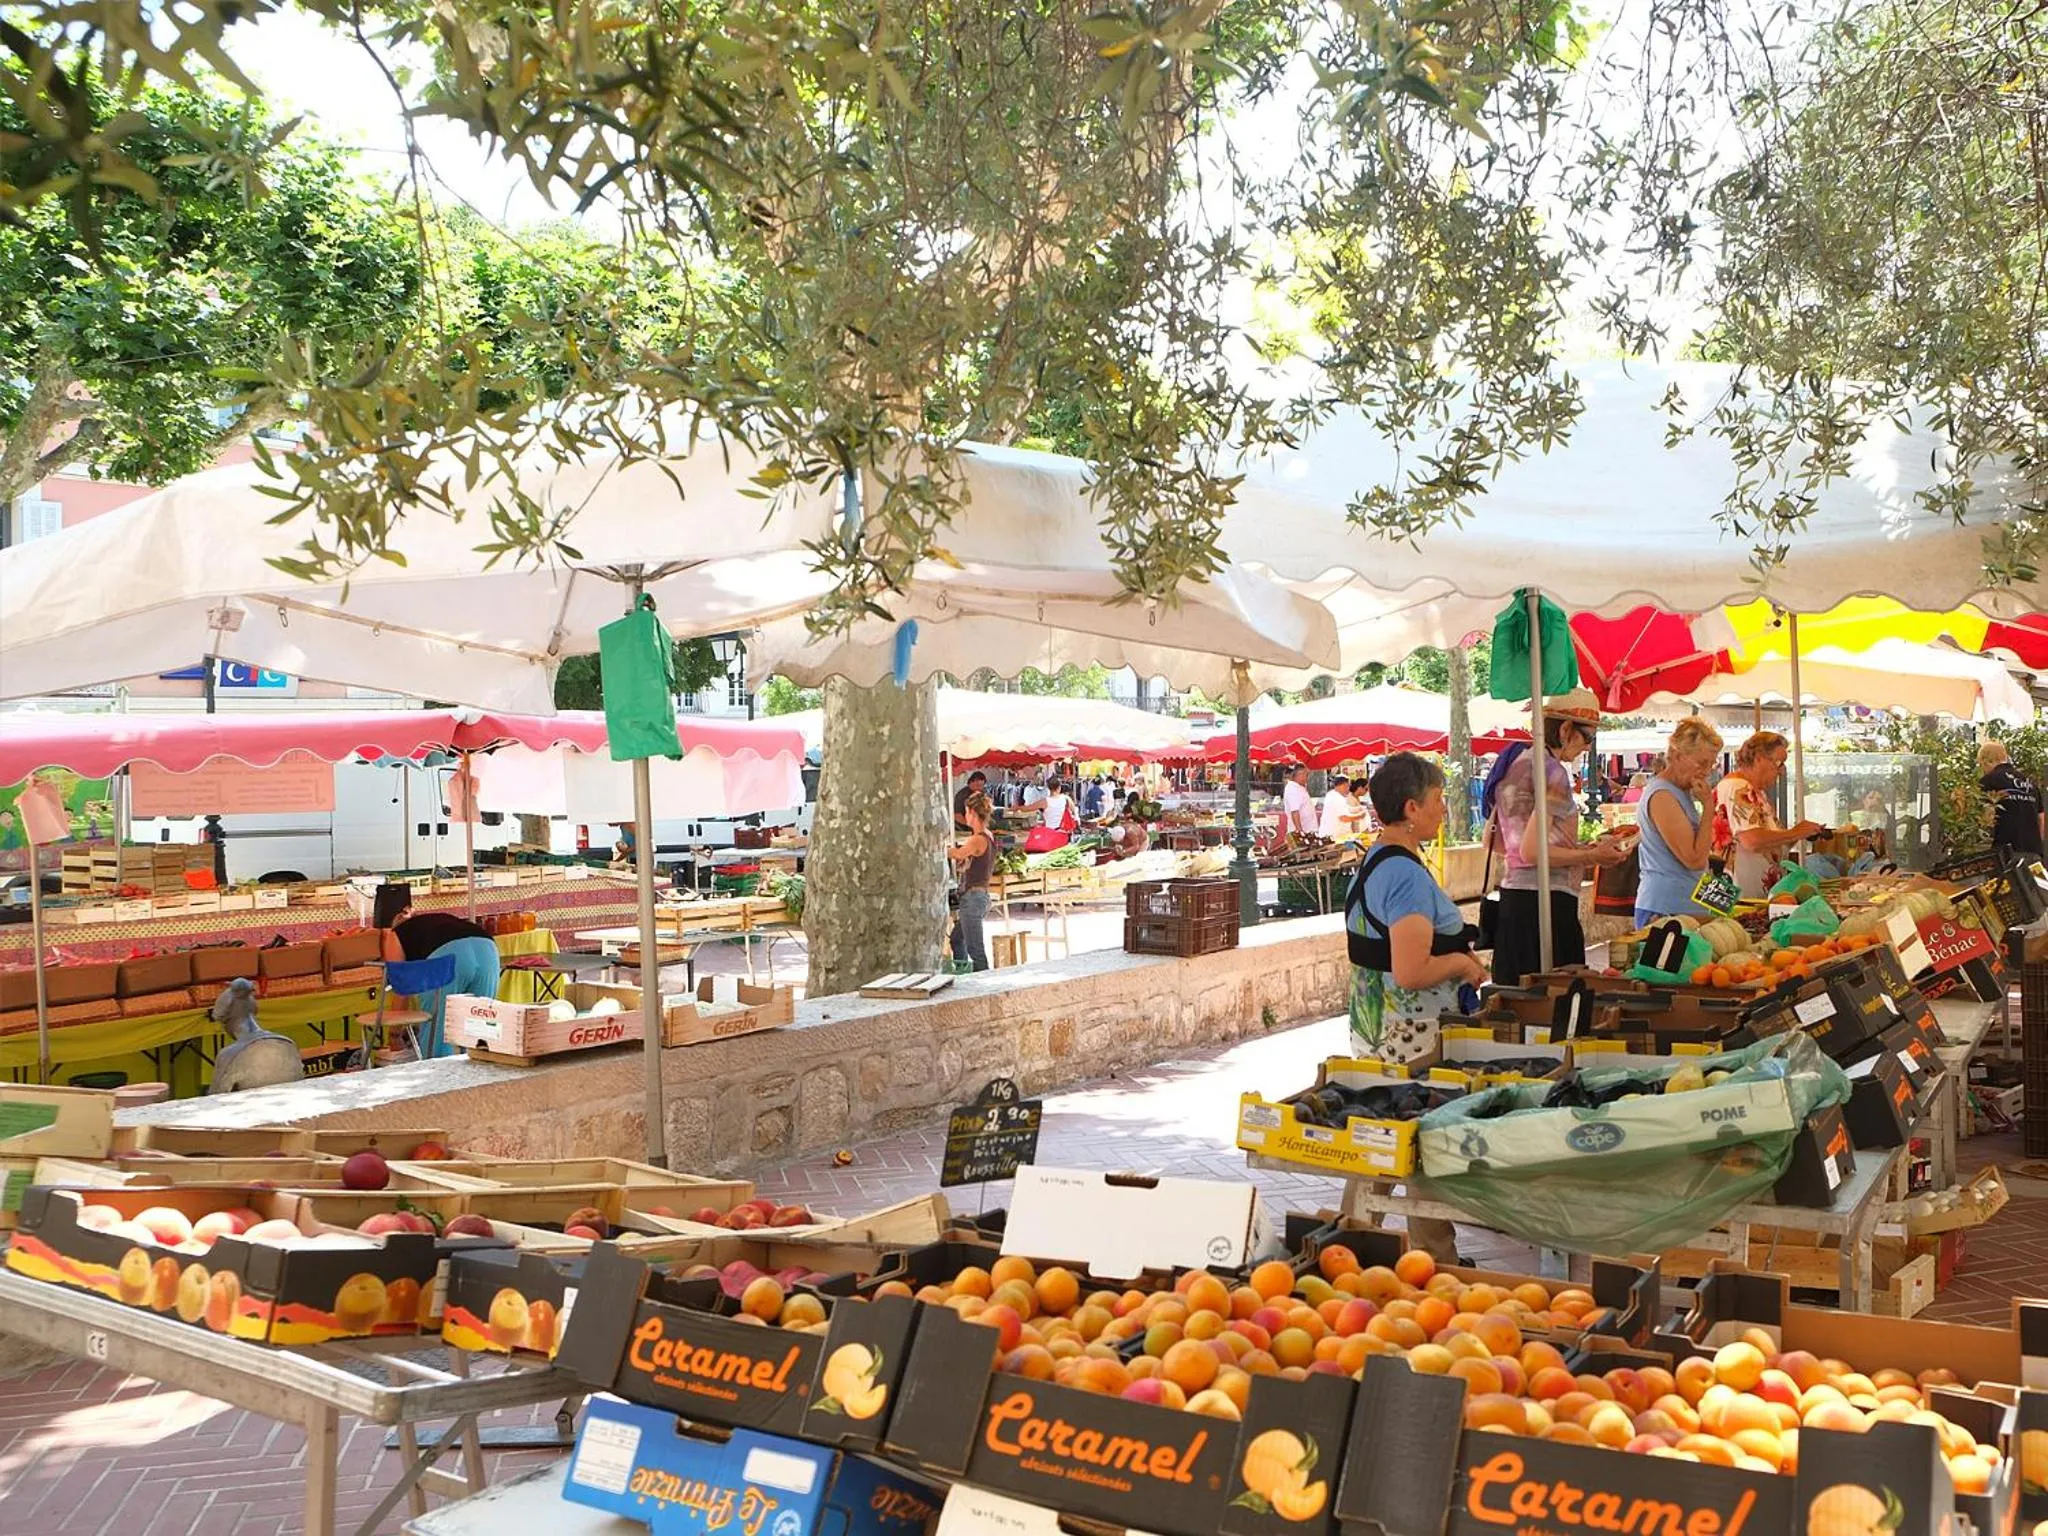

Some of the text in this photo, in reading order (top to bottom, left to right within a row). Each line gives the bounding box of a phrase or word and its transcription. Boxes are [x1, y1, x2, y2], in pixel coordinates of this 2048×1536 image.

[1927, 935, 1980, 964] Bénac
[569, 1017, 625, 1045] GERIN
[713, 1011, 758, 1036] GERIN
[1701, 1105, 1747, 1124] POME
[1278, 1136, 1359, 1164] Horticampo
[629, 1315, 800, 1393] Caramel
[985, 1391, 1208, 1484] Caramel
[1467, 1451, 1757, 1536] Caramel
